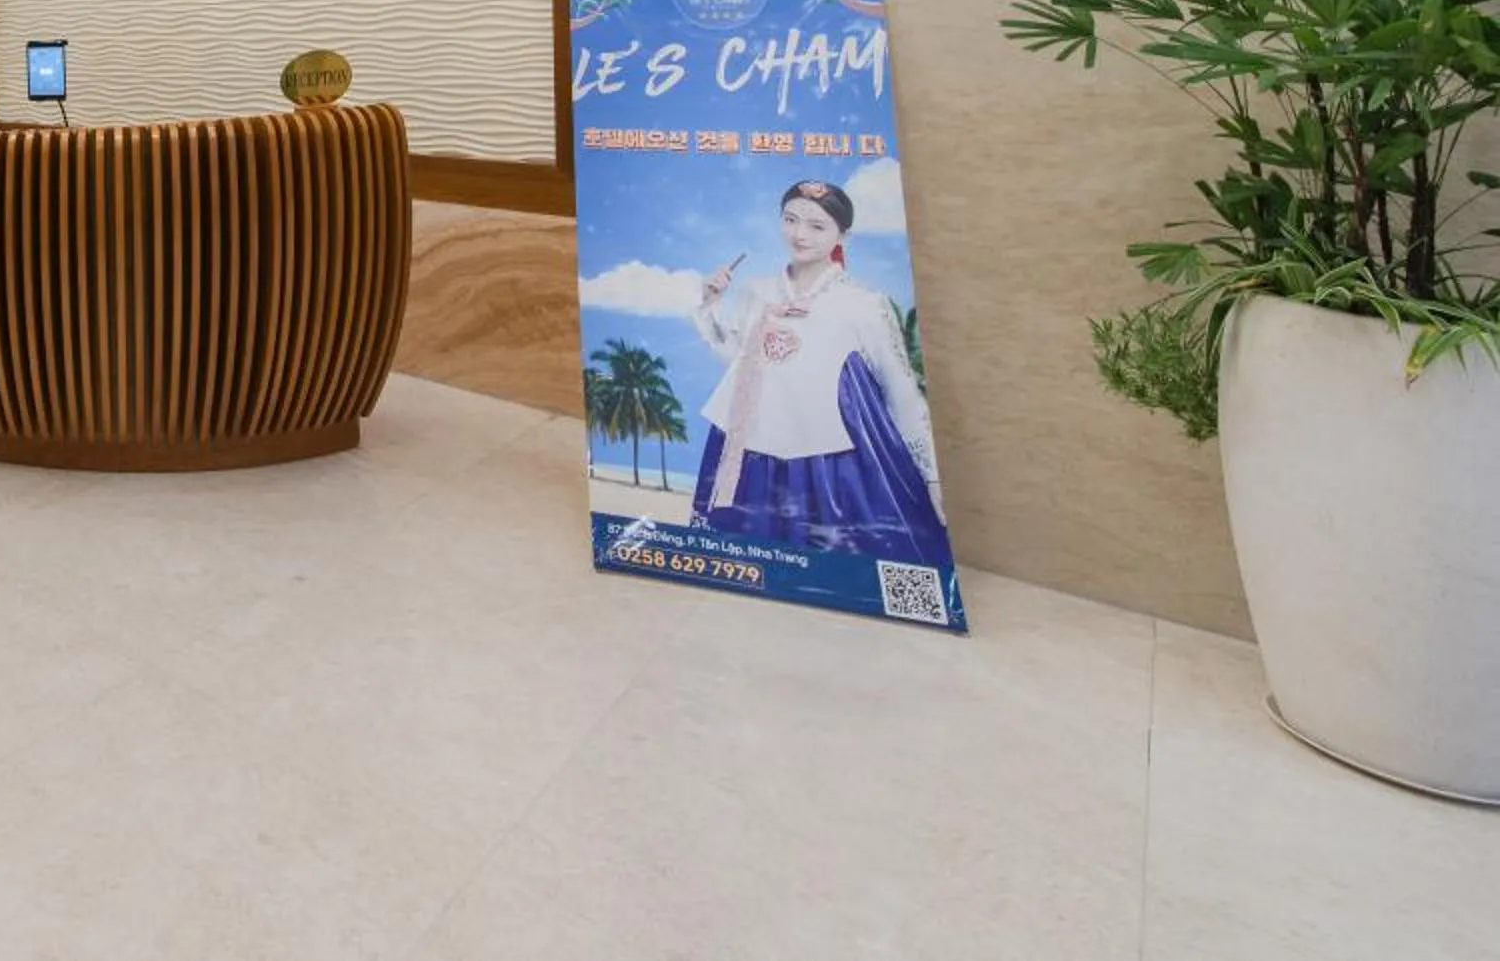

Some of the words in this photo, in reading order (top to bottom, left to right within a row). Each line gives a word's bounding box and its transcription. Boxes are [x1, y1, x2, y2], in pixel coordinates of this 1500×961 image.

[284, 69, 348, 89] RECEPTION
[715, 28, 888, 116] CHAM
[617, 545, 666, 568] 0258
[671, 553, 706, 574] 629
[710, 560, 760, 582] 7979
[748, 544, 773, 560] Nha
[774, 548, 809, 568] Trang
